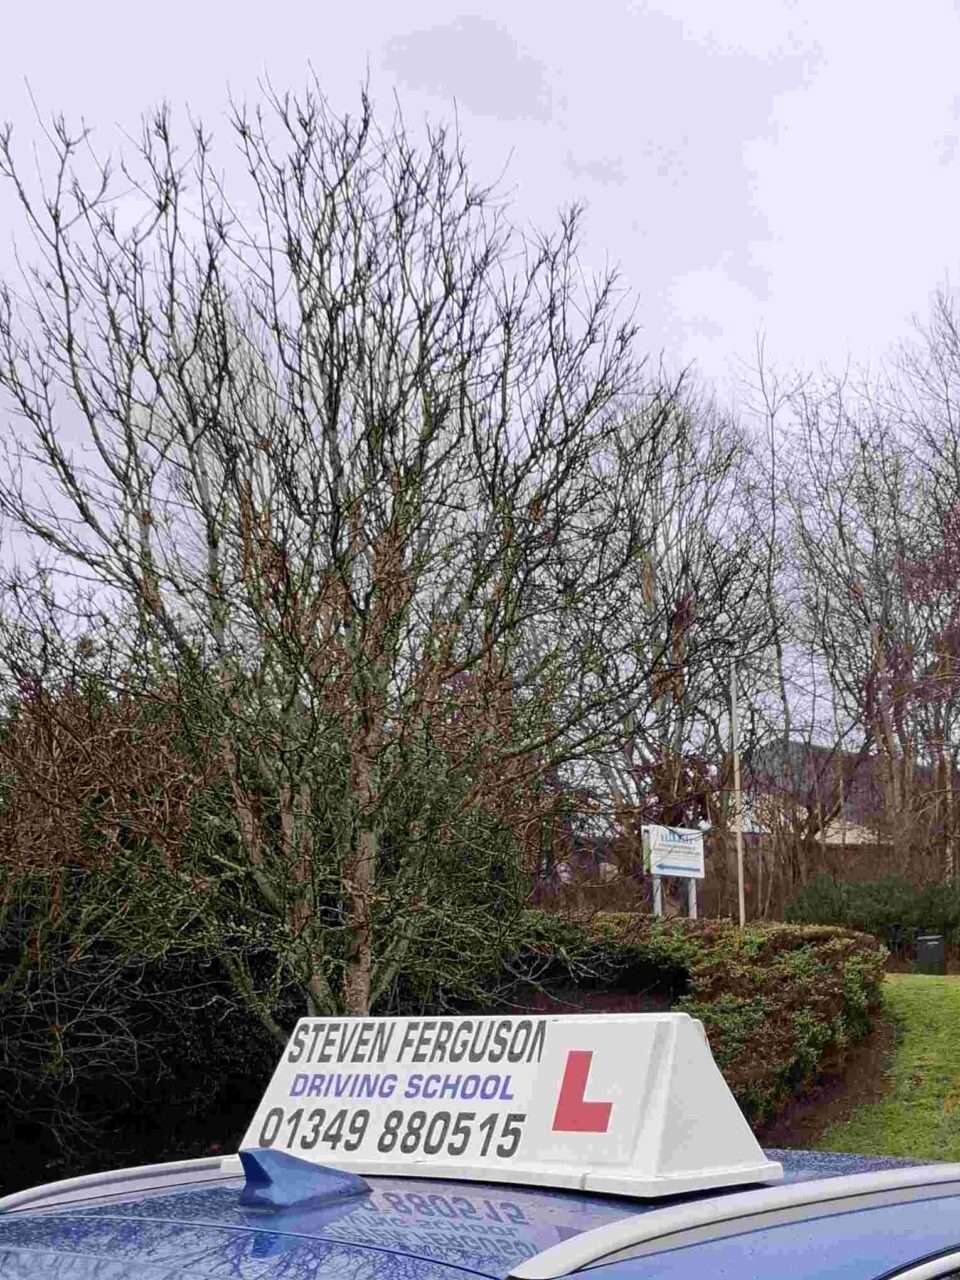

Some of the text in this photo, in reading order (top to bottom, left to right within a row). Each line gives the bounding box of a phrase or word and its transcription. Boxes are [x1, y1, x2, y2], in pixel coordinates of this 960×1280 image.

[287, 1022, 397, 1063] STEVEN
[289, 1073, 515, 1100] DRIVING SCHOOL
[552, 1051, 613, 1133] L
[258, 1106, 527, 1158] 01349 880515
